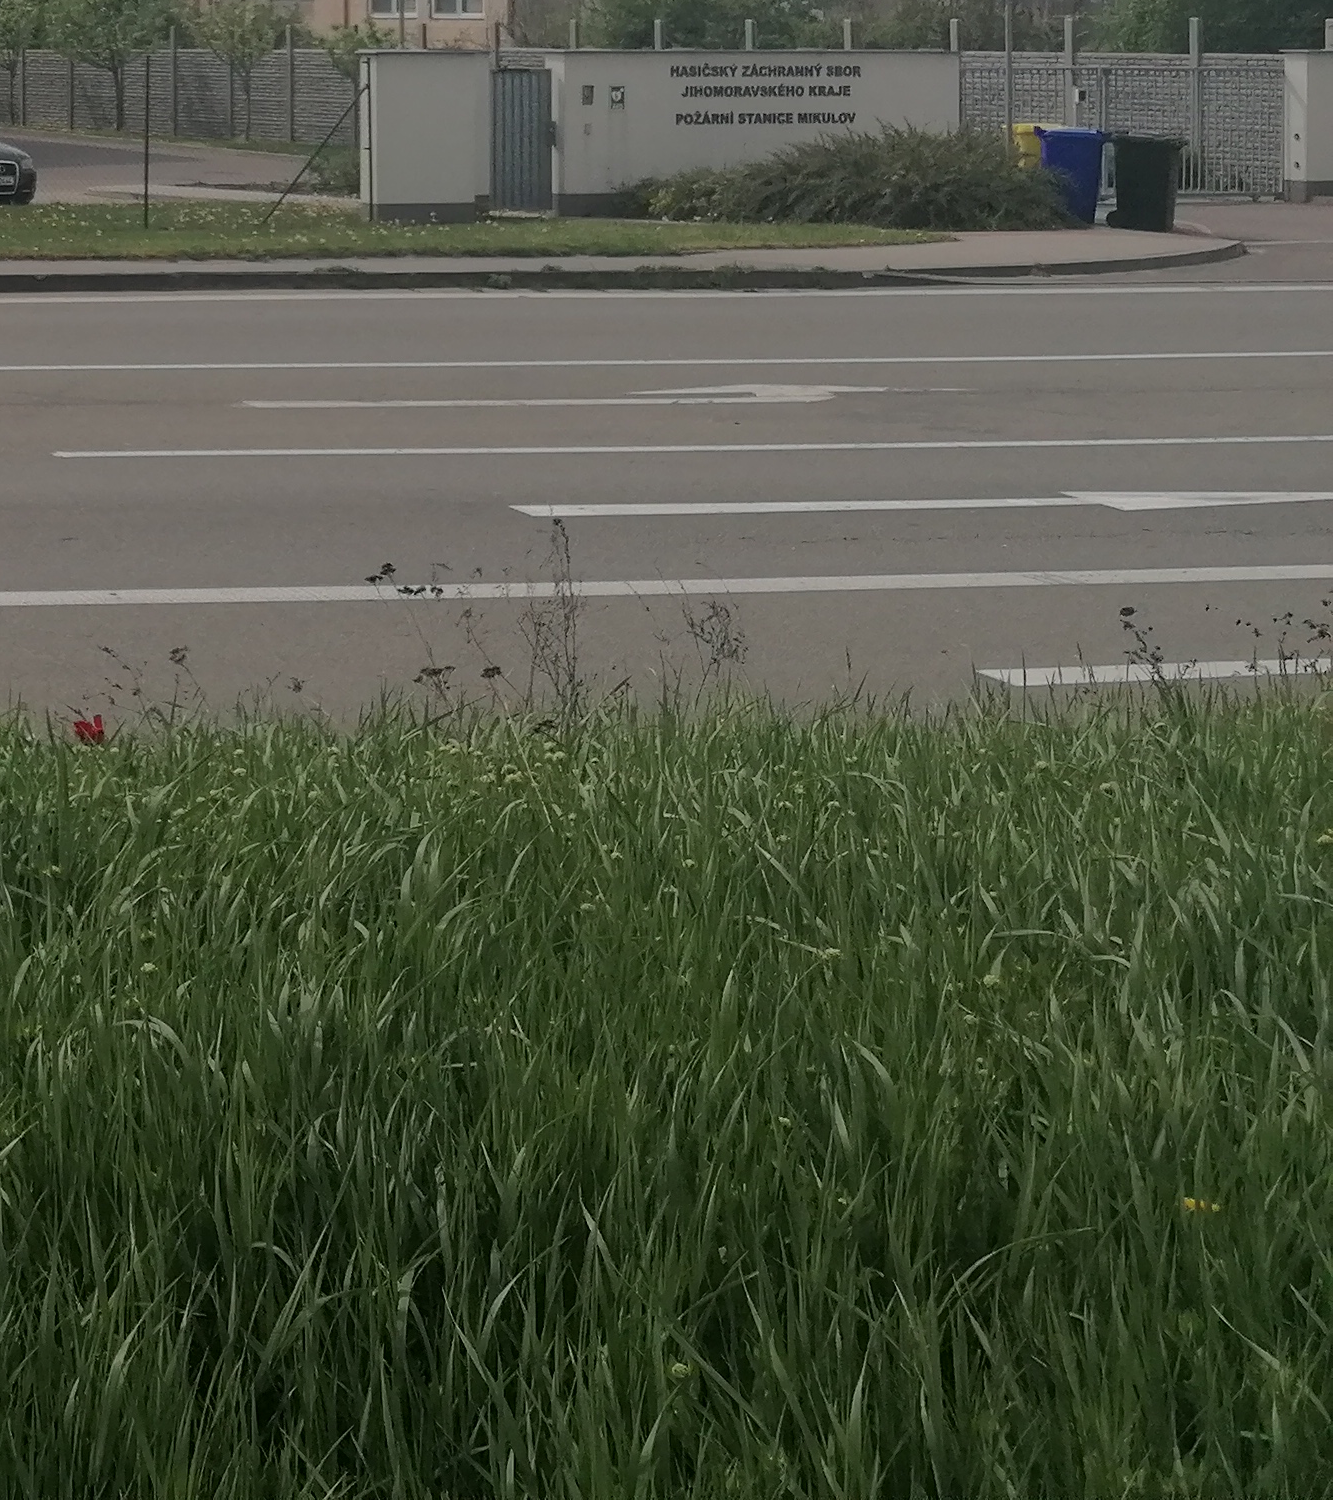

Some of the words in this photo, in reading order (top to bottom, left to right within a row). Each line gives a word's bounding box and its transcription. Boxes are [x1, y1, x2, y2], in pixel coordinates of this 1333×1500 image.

[670, 63, 738, 77] HASIČSKÝ
[741, 63, 822, 77] ZÁCHRANNÝ
[826, 65, 861, 77] SBOR
[681, 84, 804, 97] JIHOMORAVSKÉHO
[808, 85, 851, 97] KRAJE
[675, 111, 734, 125] POŽÁRNÍ
[738, 112, 793, 125] STANICE
[797, 111, 856, 124] MIKULOV
